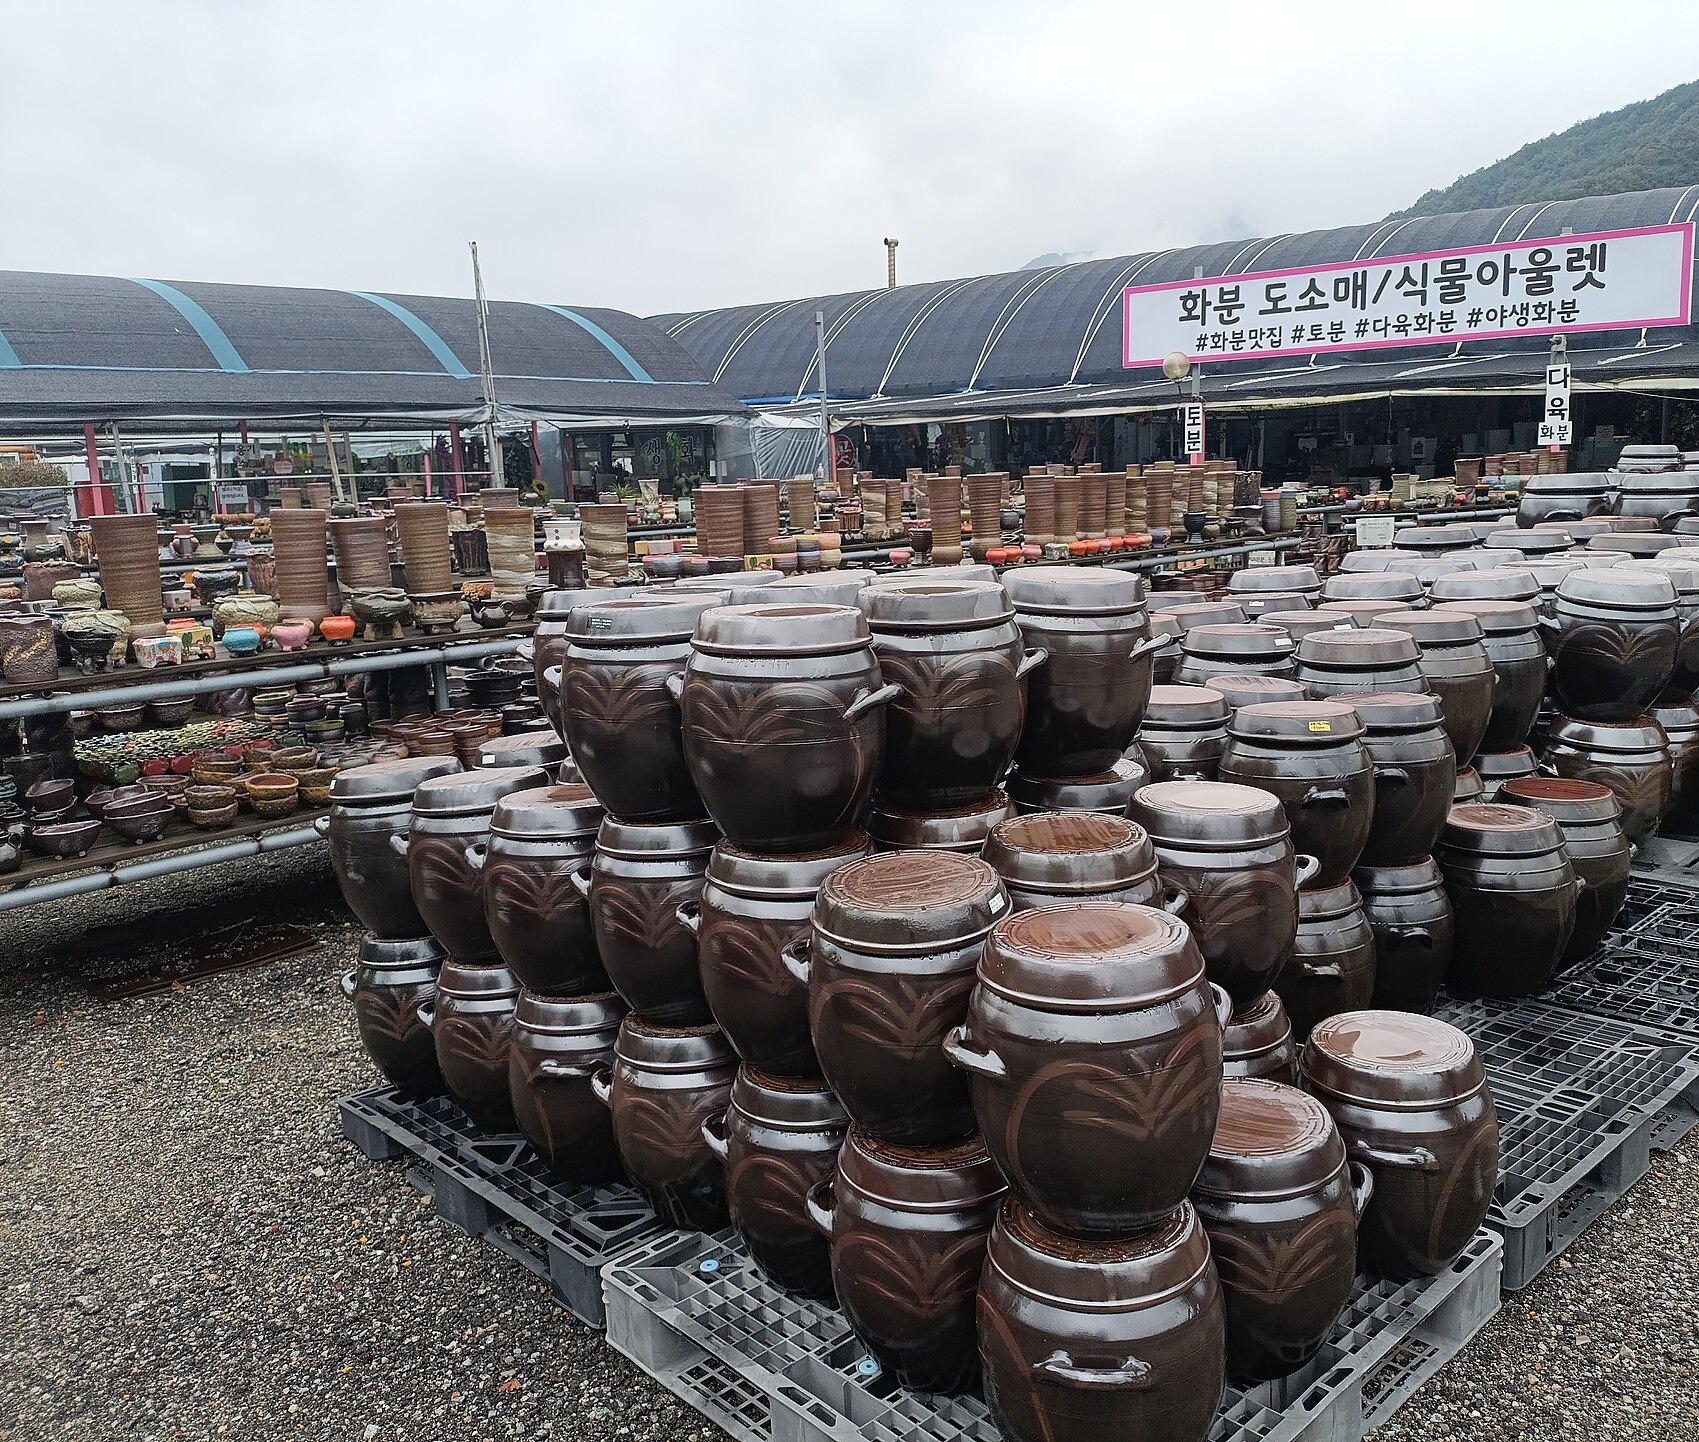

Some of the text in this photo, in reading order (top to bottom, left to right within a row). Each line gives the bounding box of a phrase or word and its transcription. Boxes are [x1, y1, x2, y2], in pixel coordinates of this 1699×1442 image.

[1179, 242, 1607, 327] 화분 도소매/식물아울렛
[1195, 299, 1580, 352] #화분맛집 #토분 #다육화분 #야생화분
[1547, 367, 1570, 421] 다육
[1186, 404, 1202, 452] 토분
[1540, 424, 1570, 442] 화분
